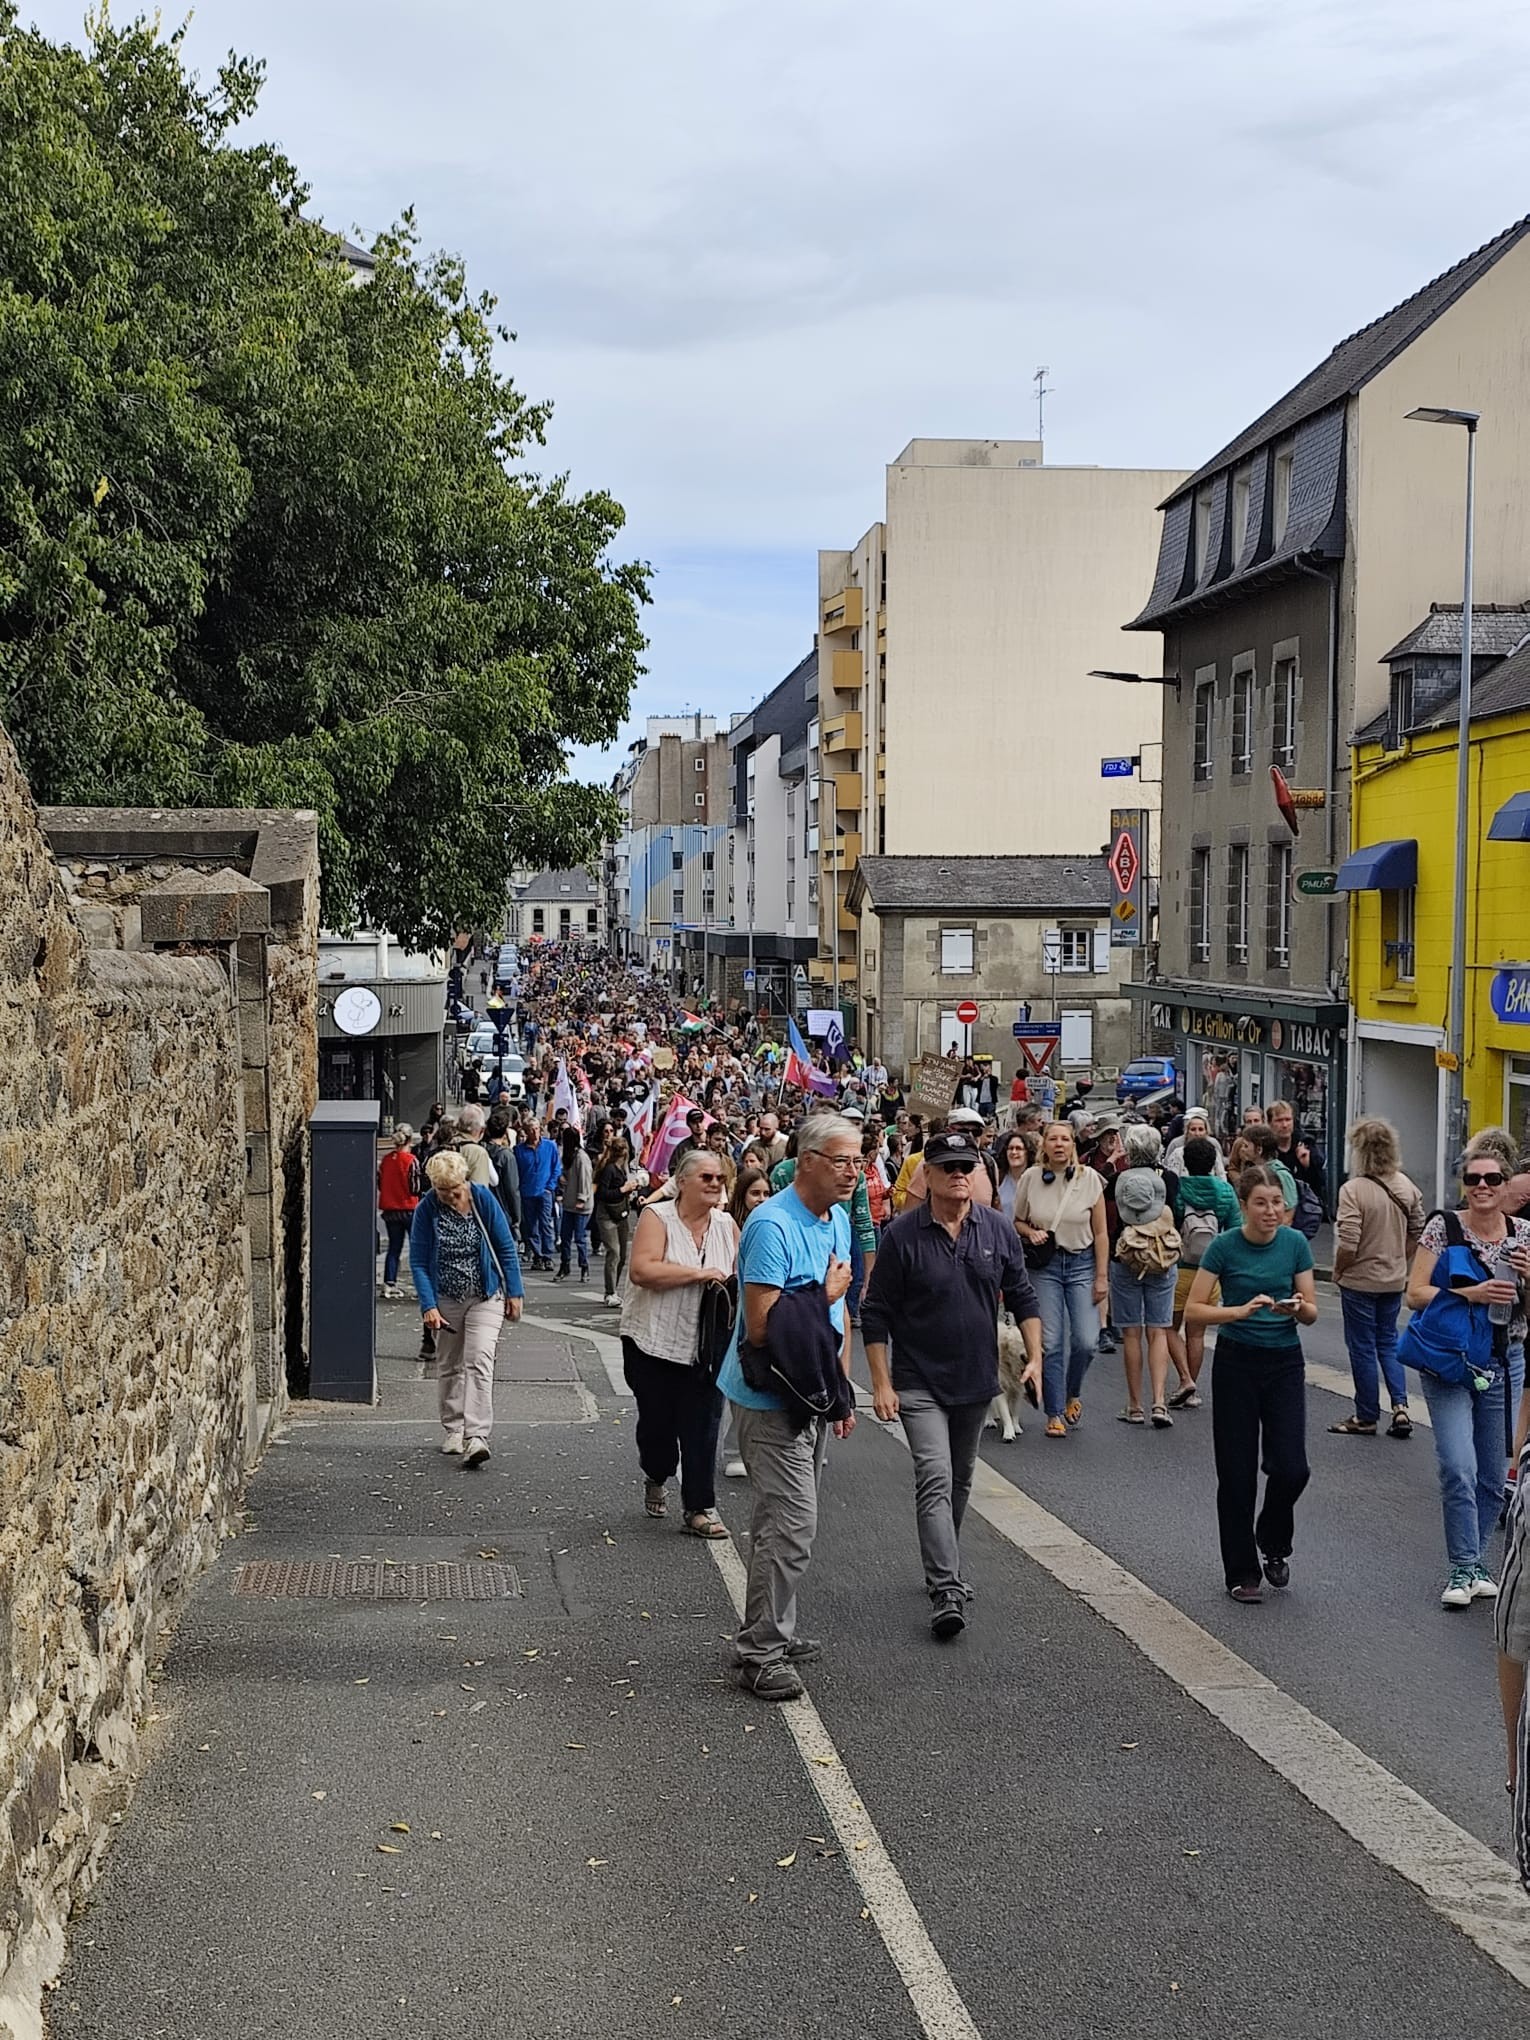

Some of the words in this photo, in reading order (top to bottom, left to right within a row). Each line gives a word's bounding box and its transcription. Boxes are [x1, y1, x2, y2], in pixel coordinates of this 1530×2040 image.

[1112, 815, 1139, 828] BAR
[1119, 841, 1131, 884] TABAC
[1301, 880, 1323, 889] PMU
[1504, 978, 1530, 1013] BA
[1193, 1011, 1203, 1035] Le
[1205, 1014, 1235, 1040] Grillon
[1237, 1018, 1262, 1045] Or
[1290, 1025, 1330, 1057] TABAC
